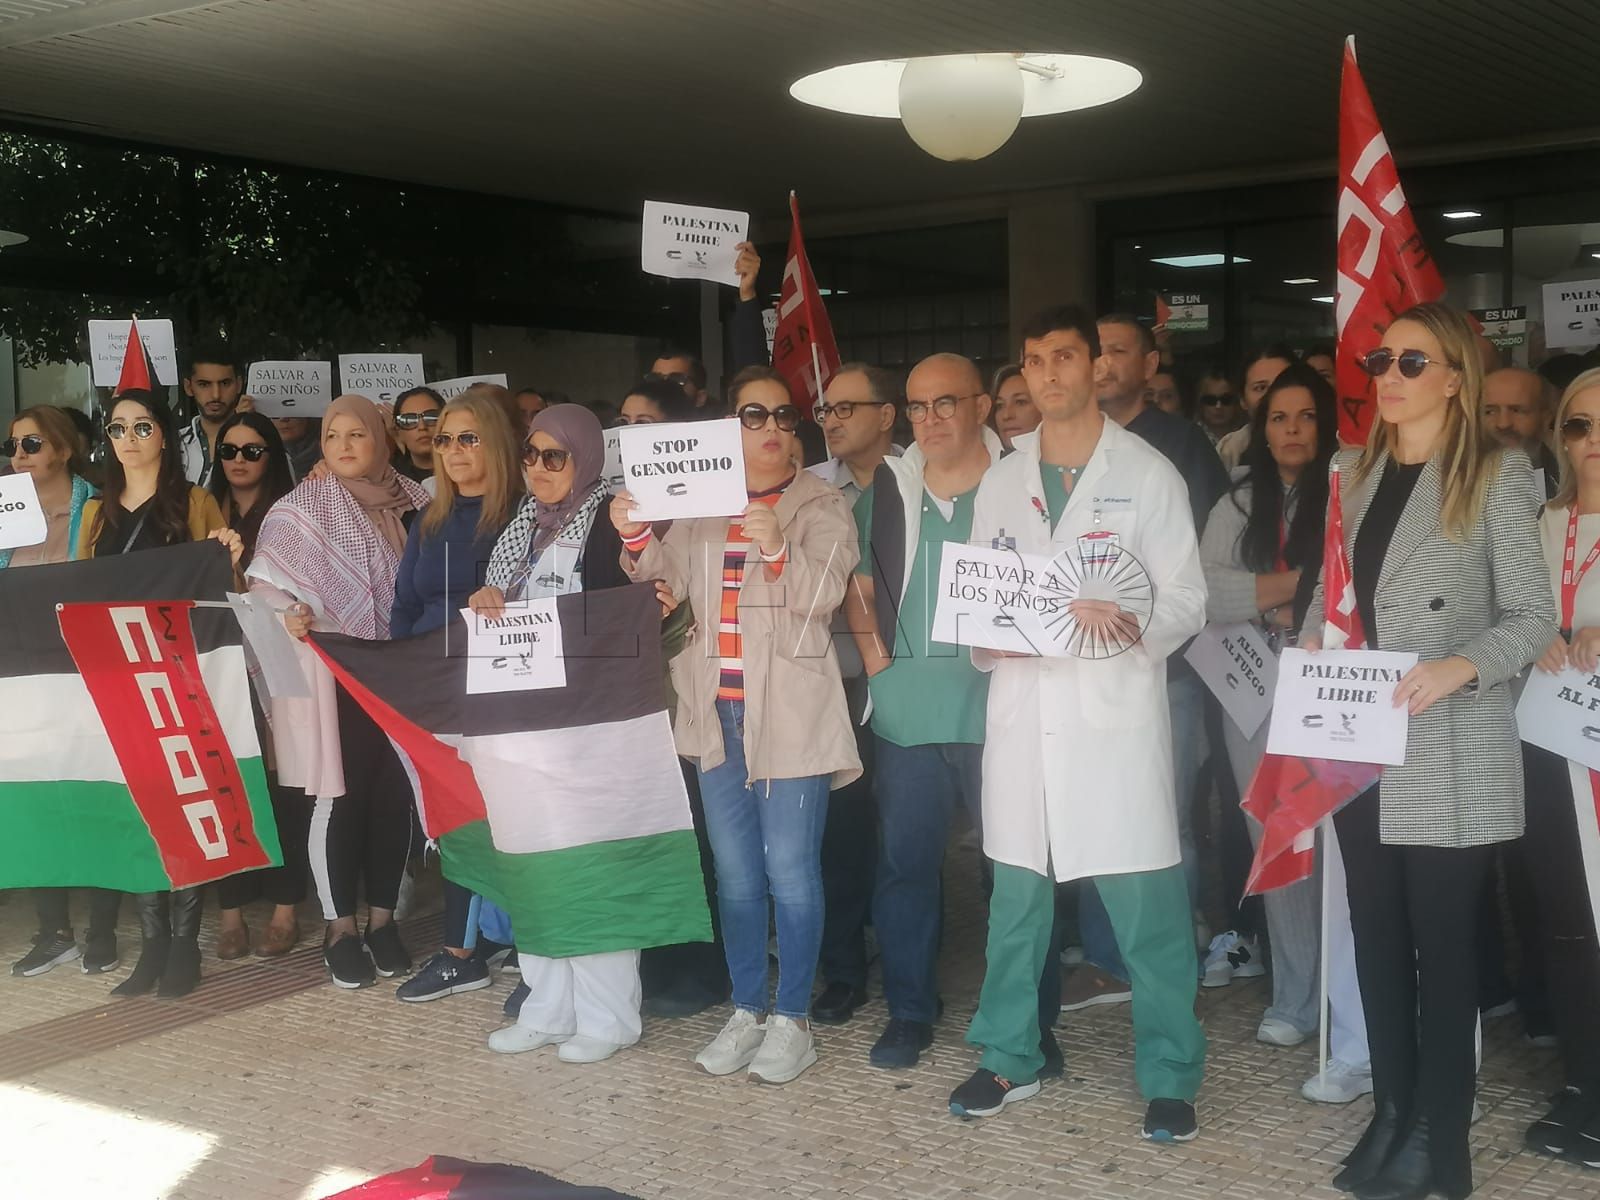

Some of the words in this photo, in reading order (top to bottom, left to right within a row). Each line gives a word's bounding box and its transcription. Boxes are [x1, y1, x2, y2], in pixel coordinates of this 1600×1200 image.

[662, 214, 740, 233] PALESTINA
[676, 232, 721, 247] LIBRE
[1171, 295, 1185, 305] ES
[1186, 294, 1201, 304] UN
[1485, 310, 1500, 321] ES
[1501, 308, 1518, 320] UN
[255, 369, 305, 380] SALVAR
[311, 370, 320, 380] A
[350, 362, 398, 374] SALVAR
[404, 362, 413, 374] A
[251, 384, 276, 395] LOS
[280, 382, 320, 395] NIÑOS
[347, 377, 373, 389] LOS
[375, 375, 414, 389] NIÑOS
[652, 438, 699, 455] STOP
[630, 456, 733, 478] GENOCIDIO
[956, 559, 1035, 586] SALVAR
[1047, 574, 1061, 590] A
[948, 582, 988, 603] LOS
[994, 589, 1060, 614] NIÑOS
[484, 612, 553, 629] PALESTINA
[499, 631, 541, 646] LIBRE
[1237, 635, 1264, 669] ALTO
[1221, 637, 1235, 656] AL
[1234, 653, 1266, 697] FUEGO
[1301, 664, 1403, 683] PALESTINA
[1316, 686, 1378, 704] LIBRE
[1557, 685, 1584, 707] AL
[108, 605, 230, 861] CCOO
